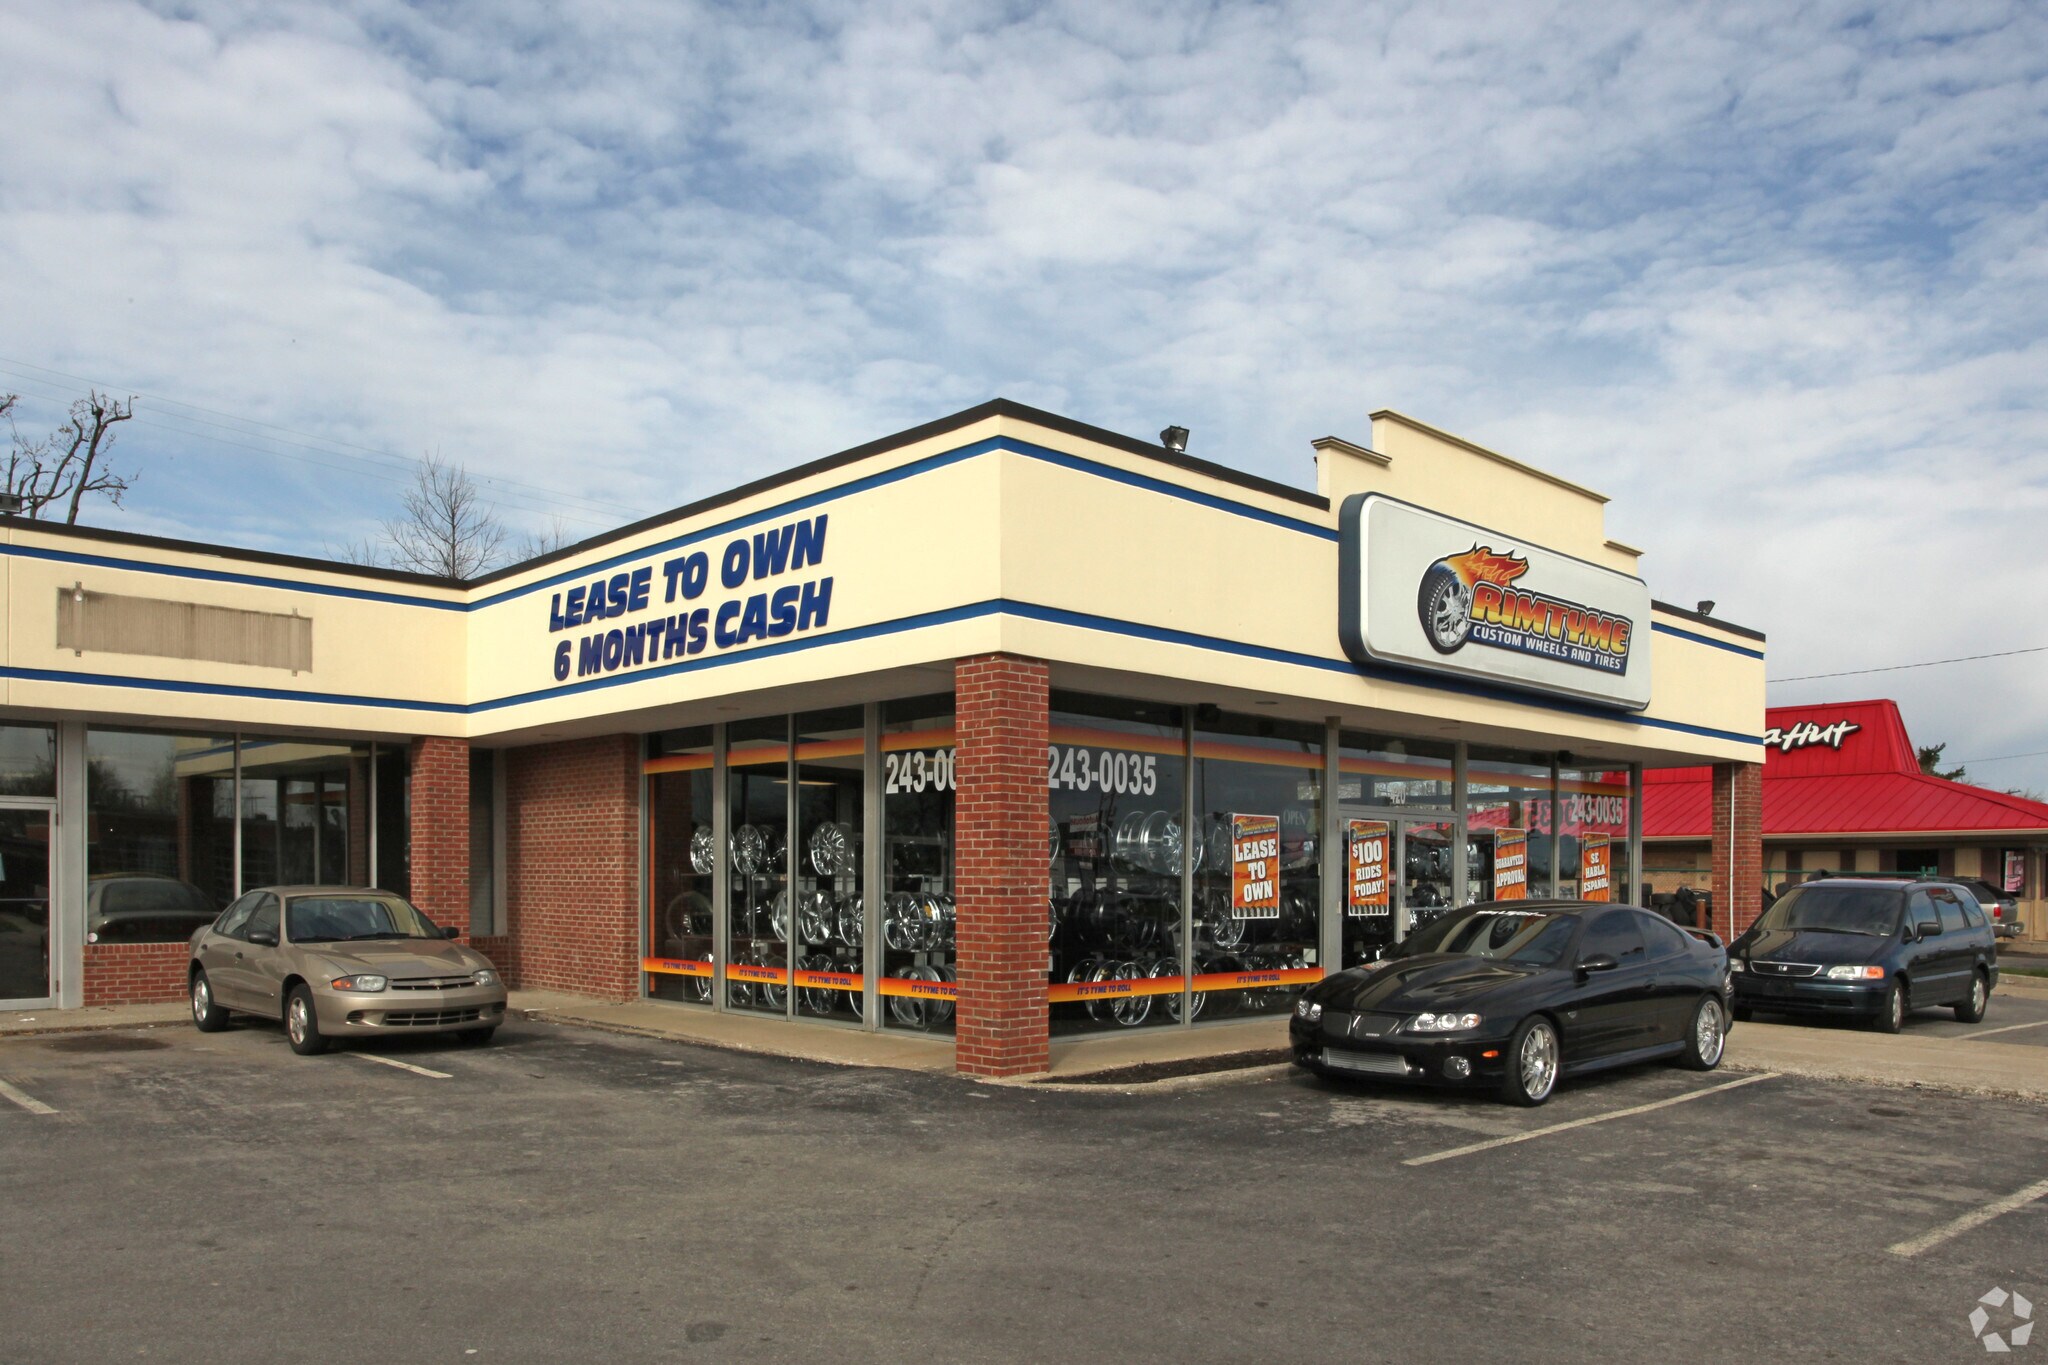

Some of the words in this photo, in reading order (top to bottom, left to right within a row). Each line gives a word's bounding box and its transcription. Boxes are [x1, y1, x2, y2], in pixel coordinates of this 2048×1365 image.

[549, 566, 652, 632] LEASE
[663, 551, 709, 603] TO
[721, 513, 828, 589] OWN
[1468, 582, 1631, 655] RIMTYME
[554, 640, 571, 681] 6
[578, 608, 709, 677] MONTHS
[714, 576, 833, 649] CASH
[1473, 625, 1522, 647] CUSTOM
[1526, 637, 1567, 657] WHEELS
[1571, 648, 1591, 663] AND
[1595, 653, 1621, 669] TIRES
[1048, 745, 1157, 796] 243-0035
[1571, 794, 1623, 824] 243-0035
[1235, 839, 1277, 862] LEASE
[1352, 840, 1382, 864] $100
[1591, 852, 1599, 864] SE
[1248, 861, 1266, 880] TO
[1496, 854, 1524, 869] GUARANTEED
[1356, 864, 1382, 881] RIDES
[1496, 869, 1525, 887] APPROVAL
[1585, 864, 1606, 878] HABLA
[1243, 880, 1273, 902] OWN
[1354, 879, 1385, 897] TODAY!
[832, 977, 839, 985] TO
[1261, 974, 1268, 982] TO
[940, 987, 948, 995] TO
[1108, 985, 1116, 993] TO
